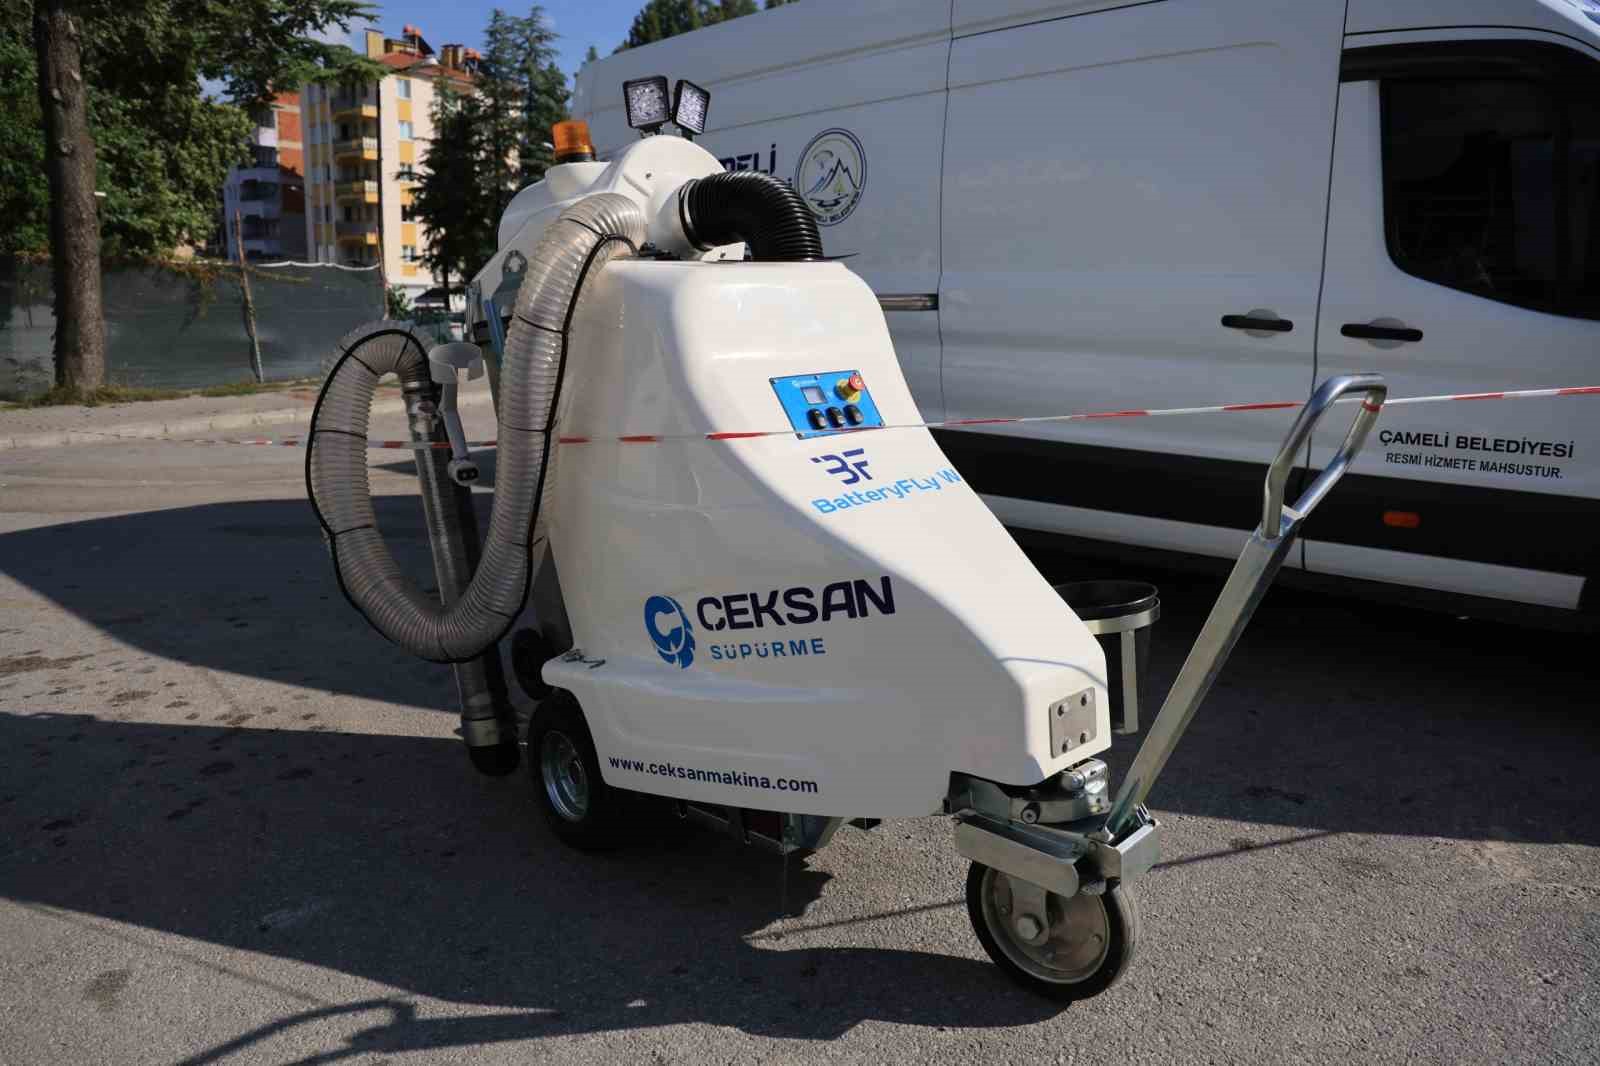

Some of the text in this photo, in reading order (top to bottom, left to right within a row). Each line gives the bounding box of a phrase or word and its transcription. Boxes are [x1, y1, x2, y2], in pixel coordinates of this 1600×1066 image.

[1379, 430, 1574, 459] ÇAMELİ BELEDİYESİ
[1385, 452, 1564, 479] RESMİ HİZMETE MAHSUSTUR.
[608, 756, 819, 794] www.ceksanmakina.com
